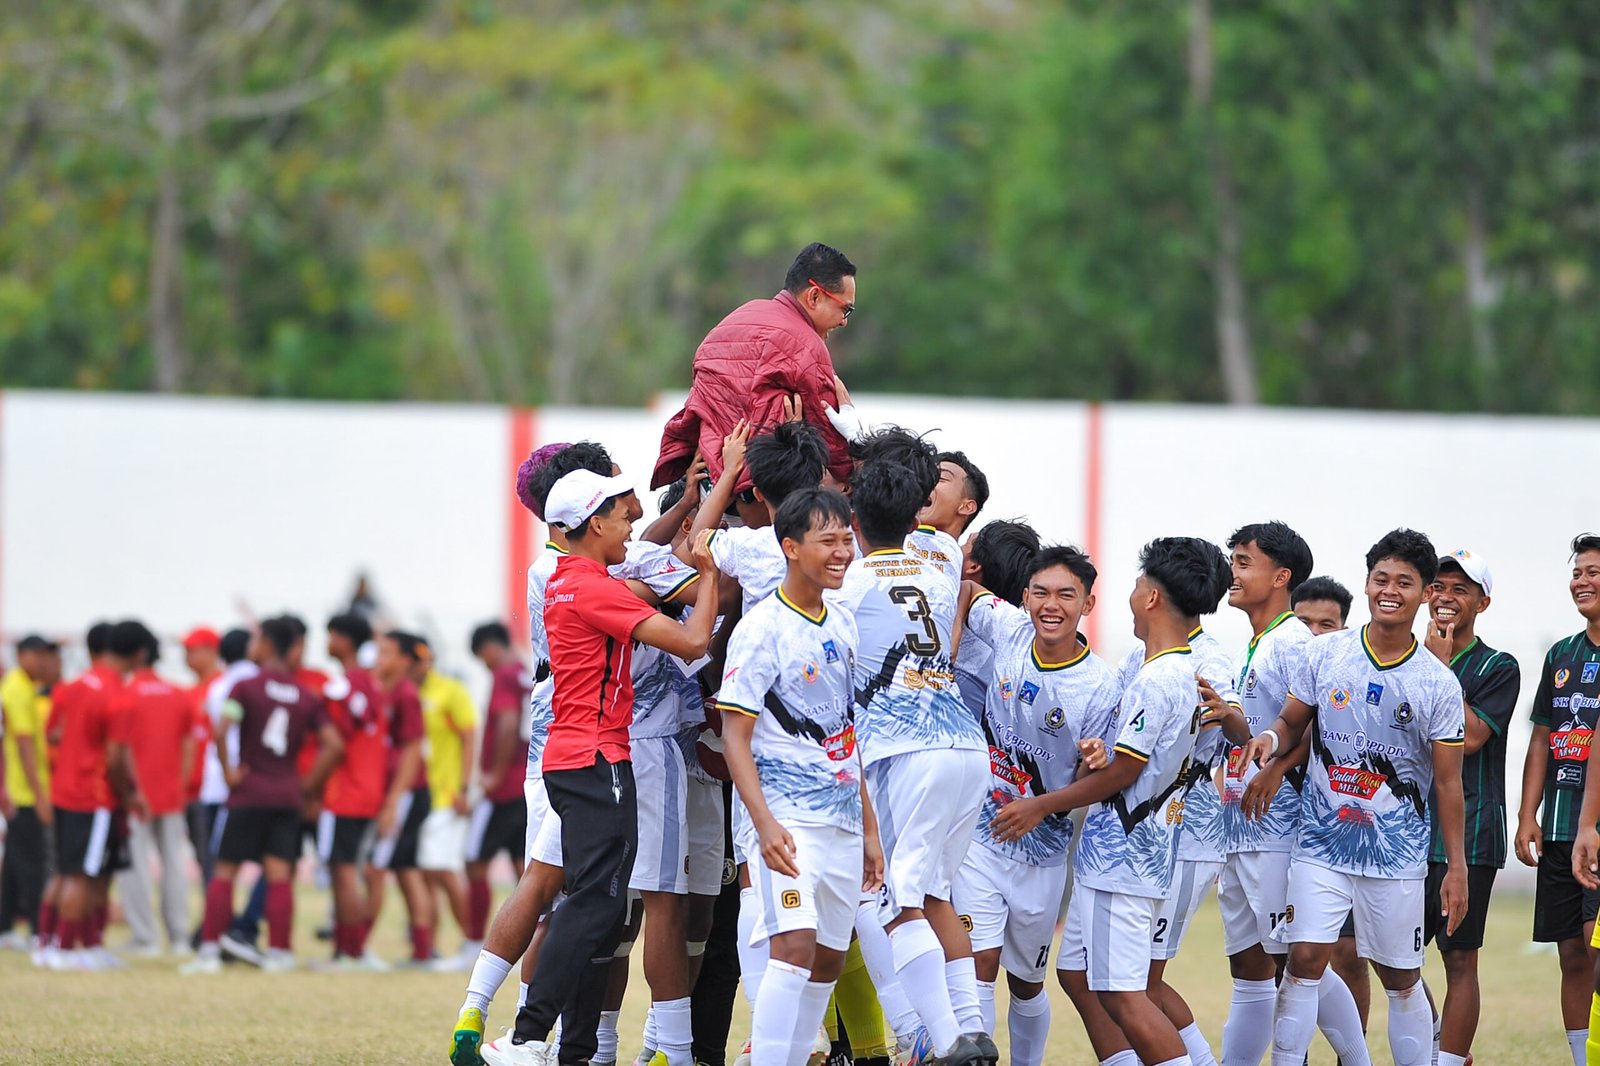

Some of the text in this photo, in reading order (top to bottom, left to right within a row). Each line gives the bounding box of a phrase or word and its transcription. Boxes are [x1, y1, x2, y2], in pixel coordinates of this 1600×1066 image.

[876, 567, 922, 577] SLEMAN
[888, 585, 942, 658] 3
[261, 706, 289, 756] 4
[1323, 730, 1352, 744] BANK
[1386, 746, 1407, 757] DIY
[1011, 735, 1033, 753] BPD
[1033, 747, 1055, 761] DIY
[1152, 918, 1169, 943] 2
[1413, 926, 1422, 952] 6
